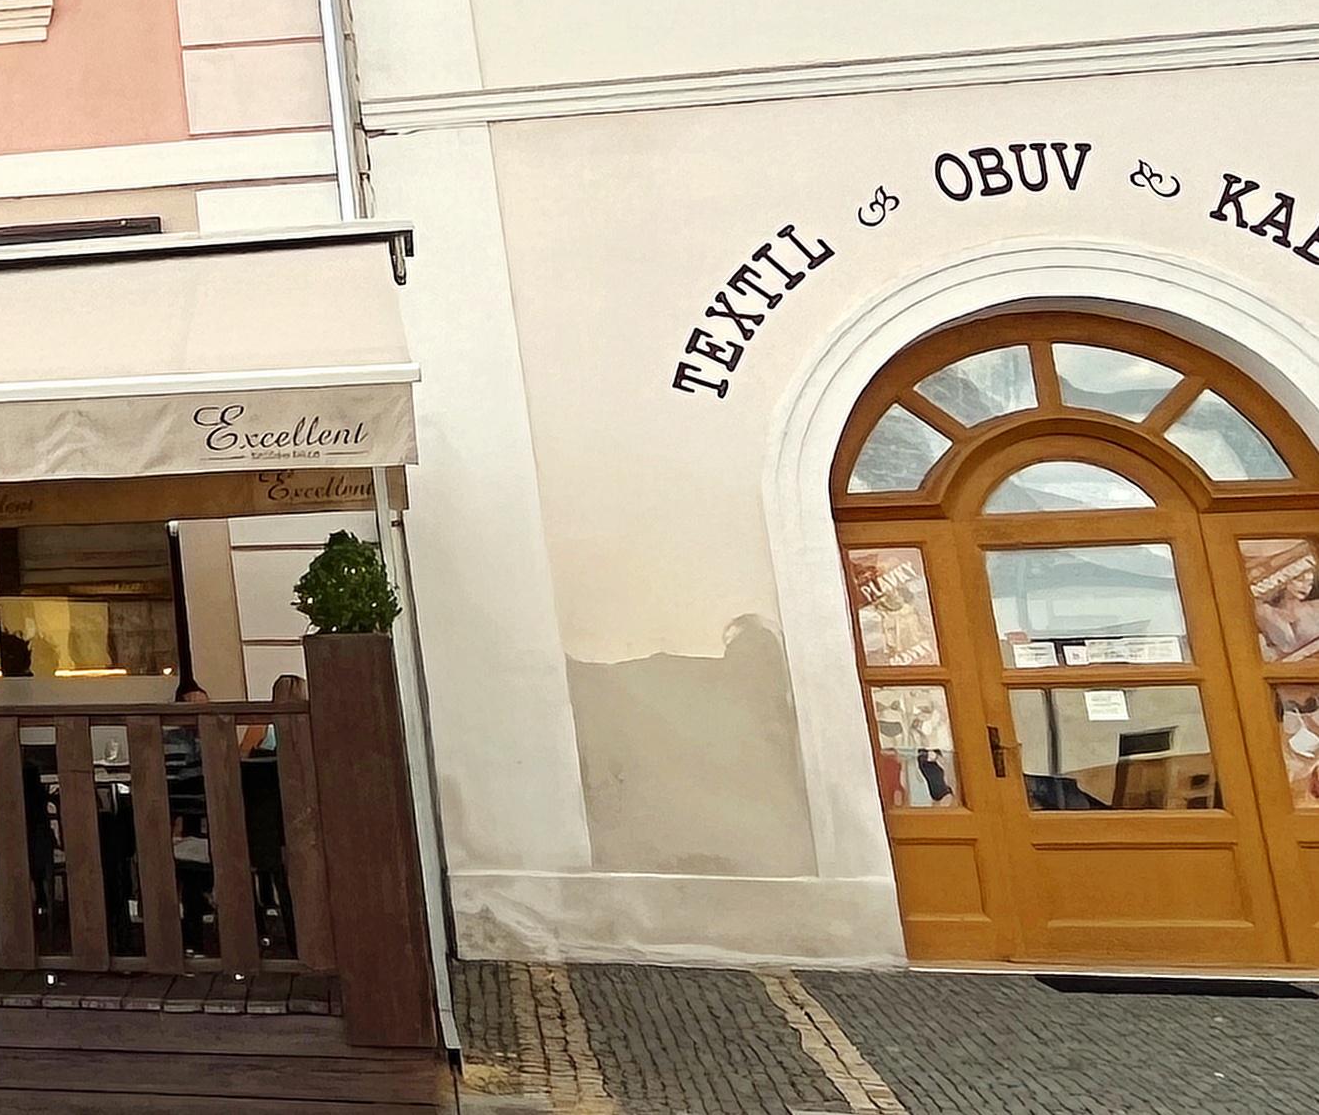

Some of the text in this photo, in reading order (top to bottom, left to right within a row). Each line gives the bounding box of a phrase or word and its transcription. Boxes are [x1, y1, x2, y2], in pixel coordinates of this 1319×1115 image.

[672, 224, 835, 399] TEXTIL
[934, 142, 1092, 202] OBUV
[193, 404, 368, 451] Excellent
[859, 560, 918, 603] PLAVKY
